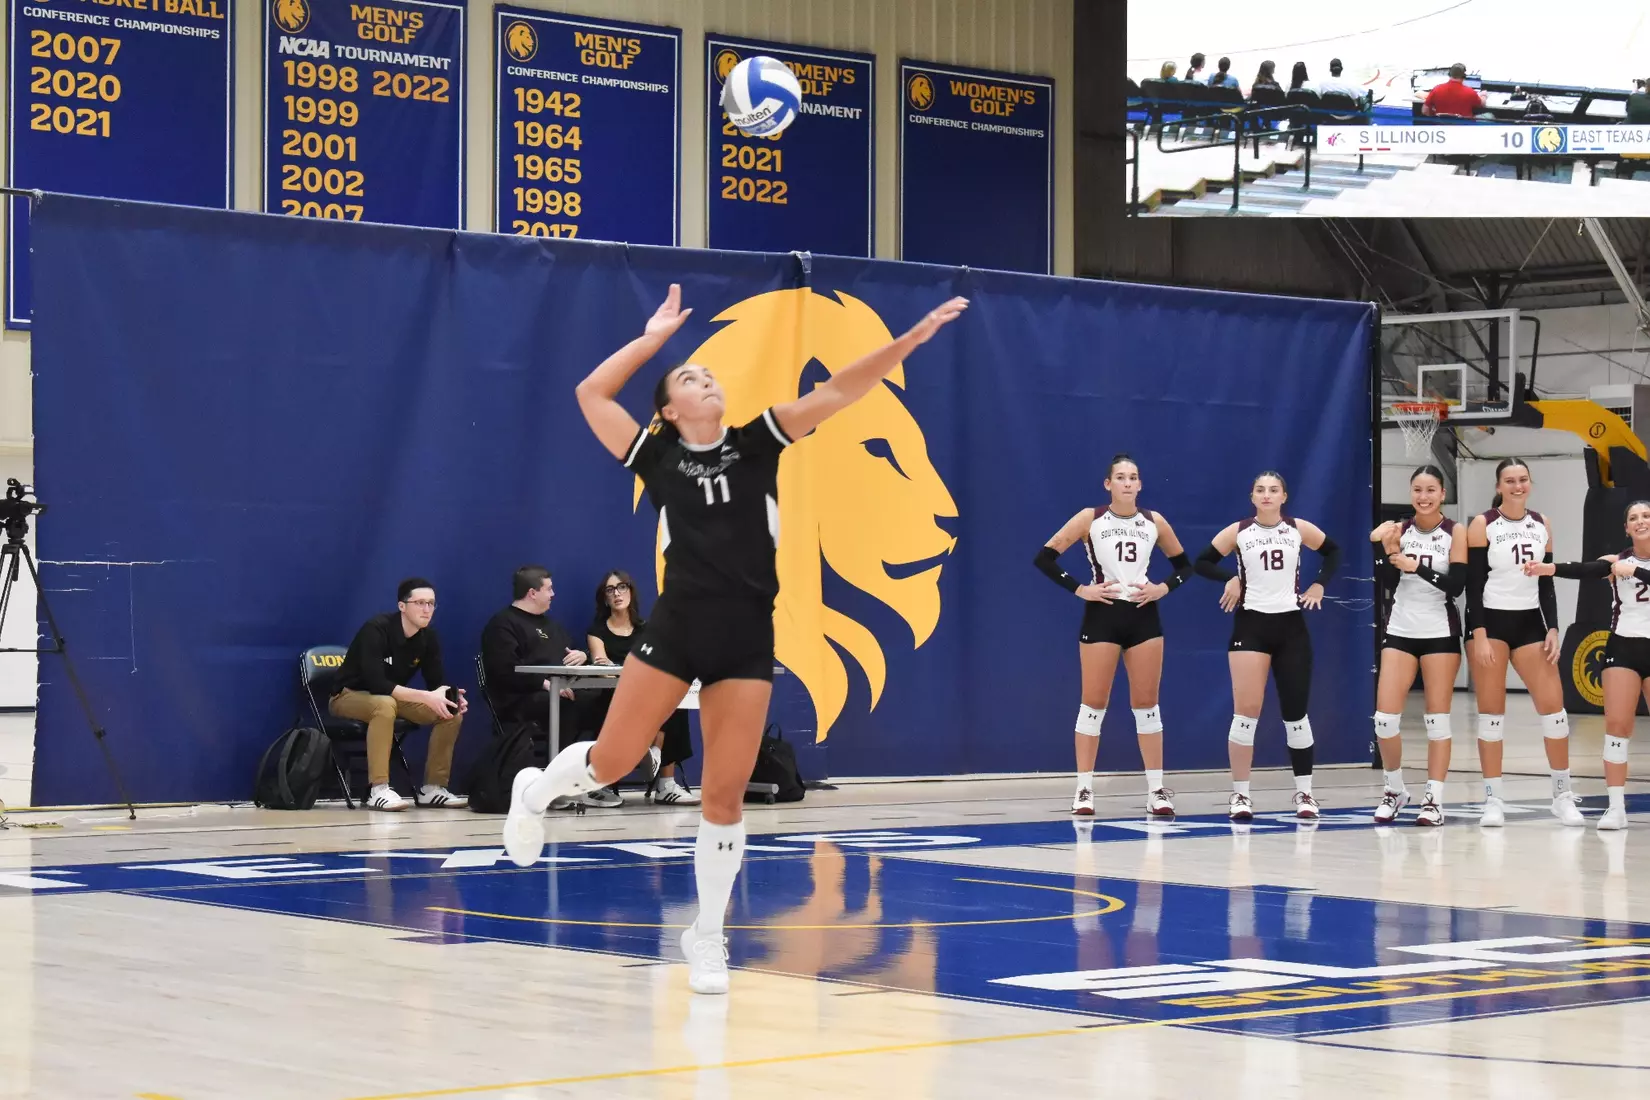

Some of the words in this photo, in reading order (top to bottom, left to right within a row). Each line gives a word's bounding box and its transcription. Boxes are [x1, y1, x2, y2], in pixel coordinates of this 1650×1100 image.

[23, 6, 110, 26] CONFERENCE
[114, 18, 220, 39] CHAMPIONSHIPS
[351, 4, 424, 29] MEN'S
[357, 22, 416, 45] GOLF
[574, 32, 642, 55] MEN'S
[31, 29, 121, 65] 2007
[279, 36, 331, 59] NCAA
[335, 45, 451, 70] TOURNAMENT
[580, 49, 635, 70] GOLF
[31, 66, 121, 102] 2020
[283, 60, 359, 93] 1998
[372, 70, 450, 103] 2022
[507, 65, 579, 83] CONFERENCE
[581, 75, 669, 93] CHAMPIONSHIPS
[784, 61, 855, 84] MEN'S
[799, 79, 833, 96] OLF
[950, 80, 1036, 105] WOMEN'S
[284, 95, 359, 127] 1999
[514, 87, 582, 118] 1942
[799, 102, 862, 120] NAMENT
[970, 98, 1015, 117] GOLF
[30, 103, 111, 138] 2021
[735, 107, 772, 126] molten
[909, 114, 969, 130] CONFERENCE
[971, 122, 1045, 138] CHAMPIONSHIPS
[282, 129, 356, 161] 2001
[513, 120, 583, 151] 1964
[1359, 130, 1369, 144] S
[1375, 130, 1446, 144] ILLINOIS
[1500, 131, 1524, 149] 10
[1572, 129, 1602, 143] EAST
[1606, 129, 1643, 143] TEXAS
[513, 153, 582, 184] 1965
[722, 143, 782, 172] 2021
[282, 164, 365, 197] 2002
[721, 175, 788, 205] 2022
[281, 199, 364, 223] 2007
[513, 187, 582, 217] 1998
[512, 219, 579, 240] 2017
[697, 473, 731, 505] 11
[1100, 528, 1128, 540] SOUTHERN
[1129, 528, 1150, 542] ILLINOIS
[1115, 540, 1137, 563] 13
[1260, 549, 1284, 571] 18
[1511, 543, 1534, 565] 15
[986, 936, 1650, 999] SLC
